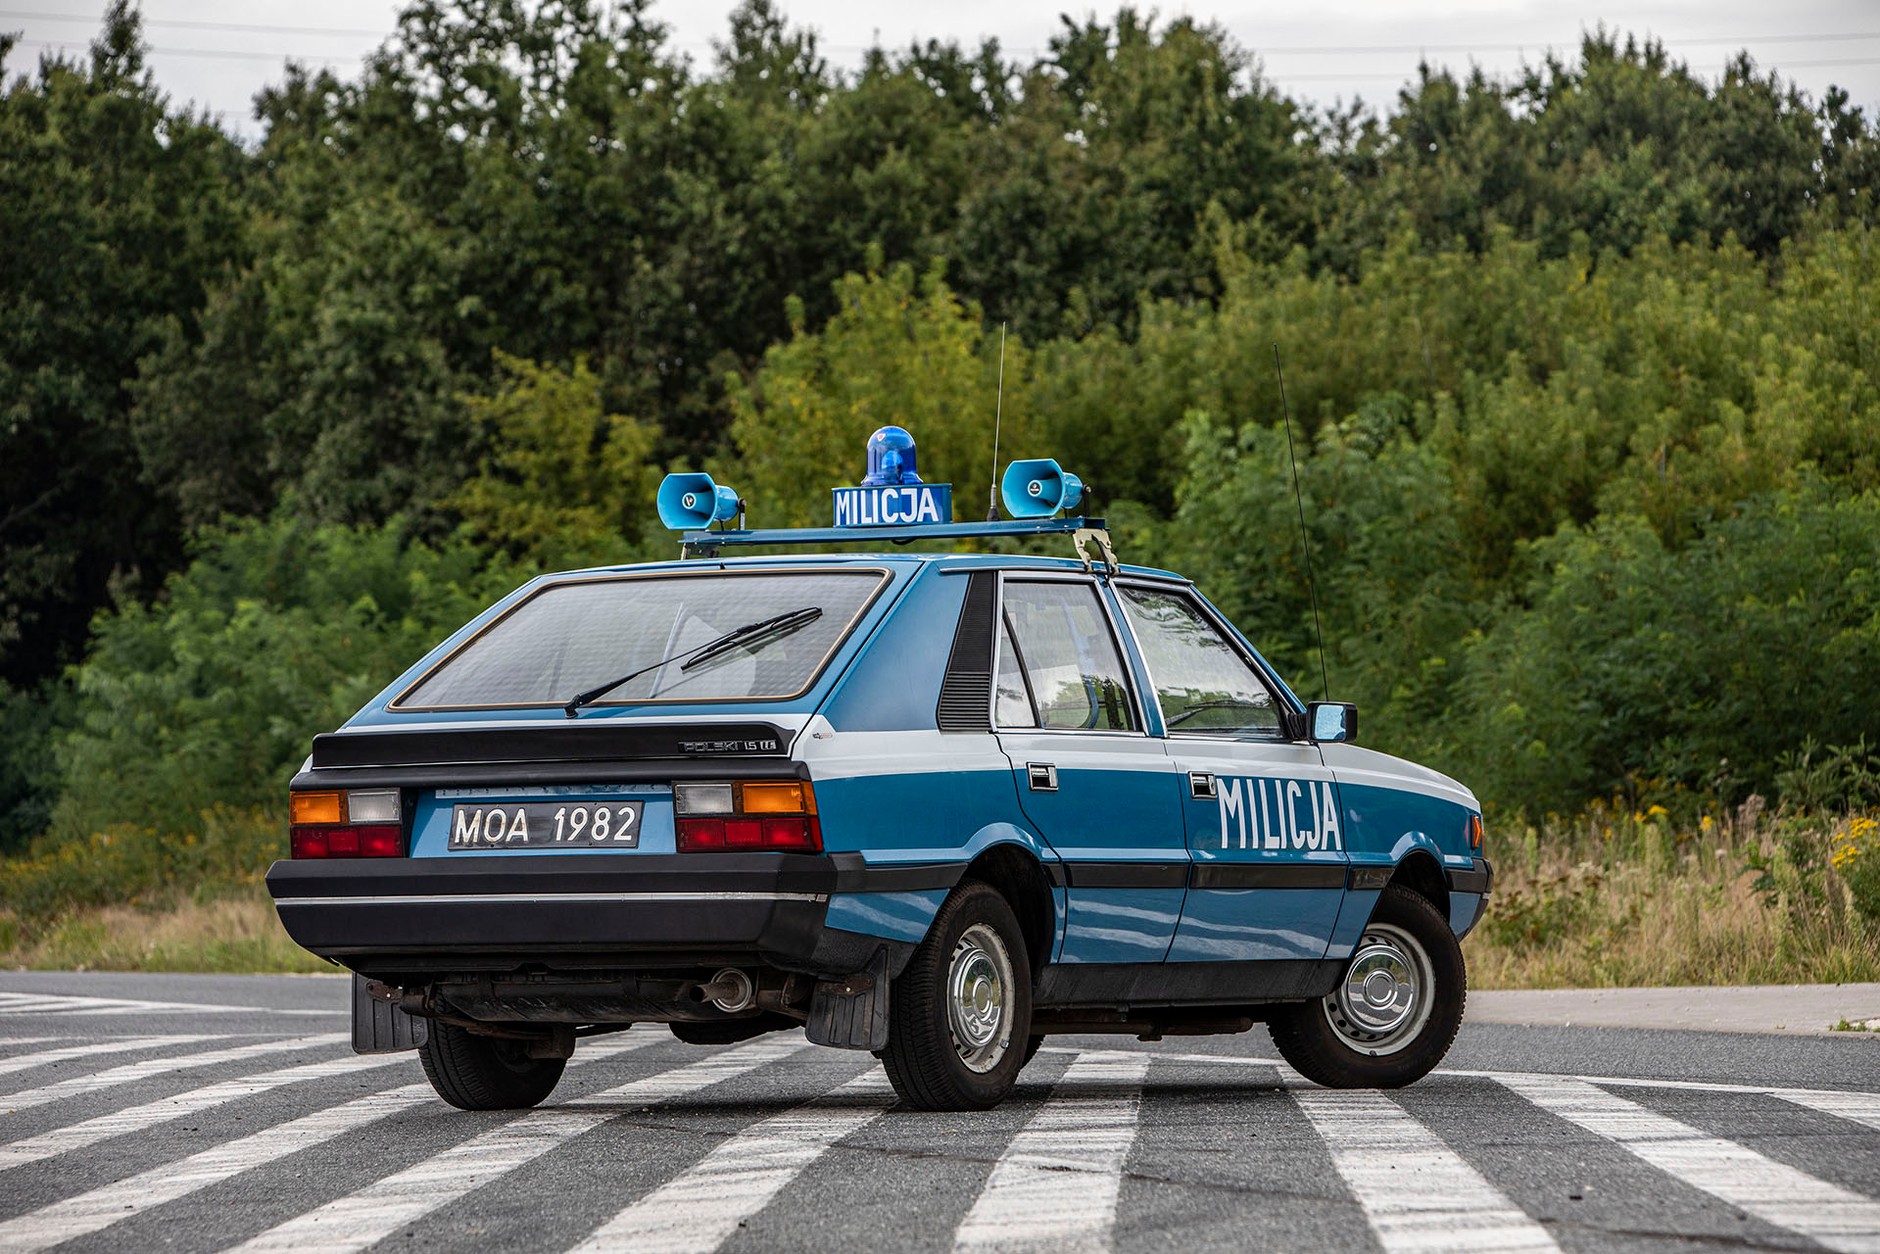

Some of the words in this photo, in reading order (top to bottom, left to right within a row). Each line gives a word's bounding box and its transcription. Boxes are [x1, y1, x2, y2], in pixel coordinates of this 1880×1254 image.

[835, 487, 939, 526] MILICJA
[684, 741, 739, 752] POLSKI
[454, 808, 529, 843] MOA
[553, 807, 636, 842] 1982
[1216, 778, 1342, 850] MILICJA
